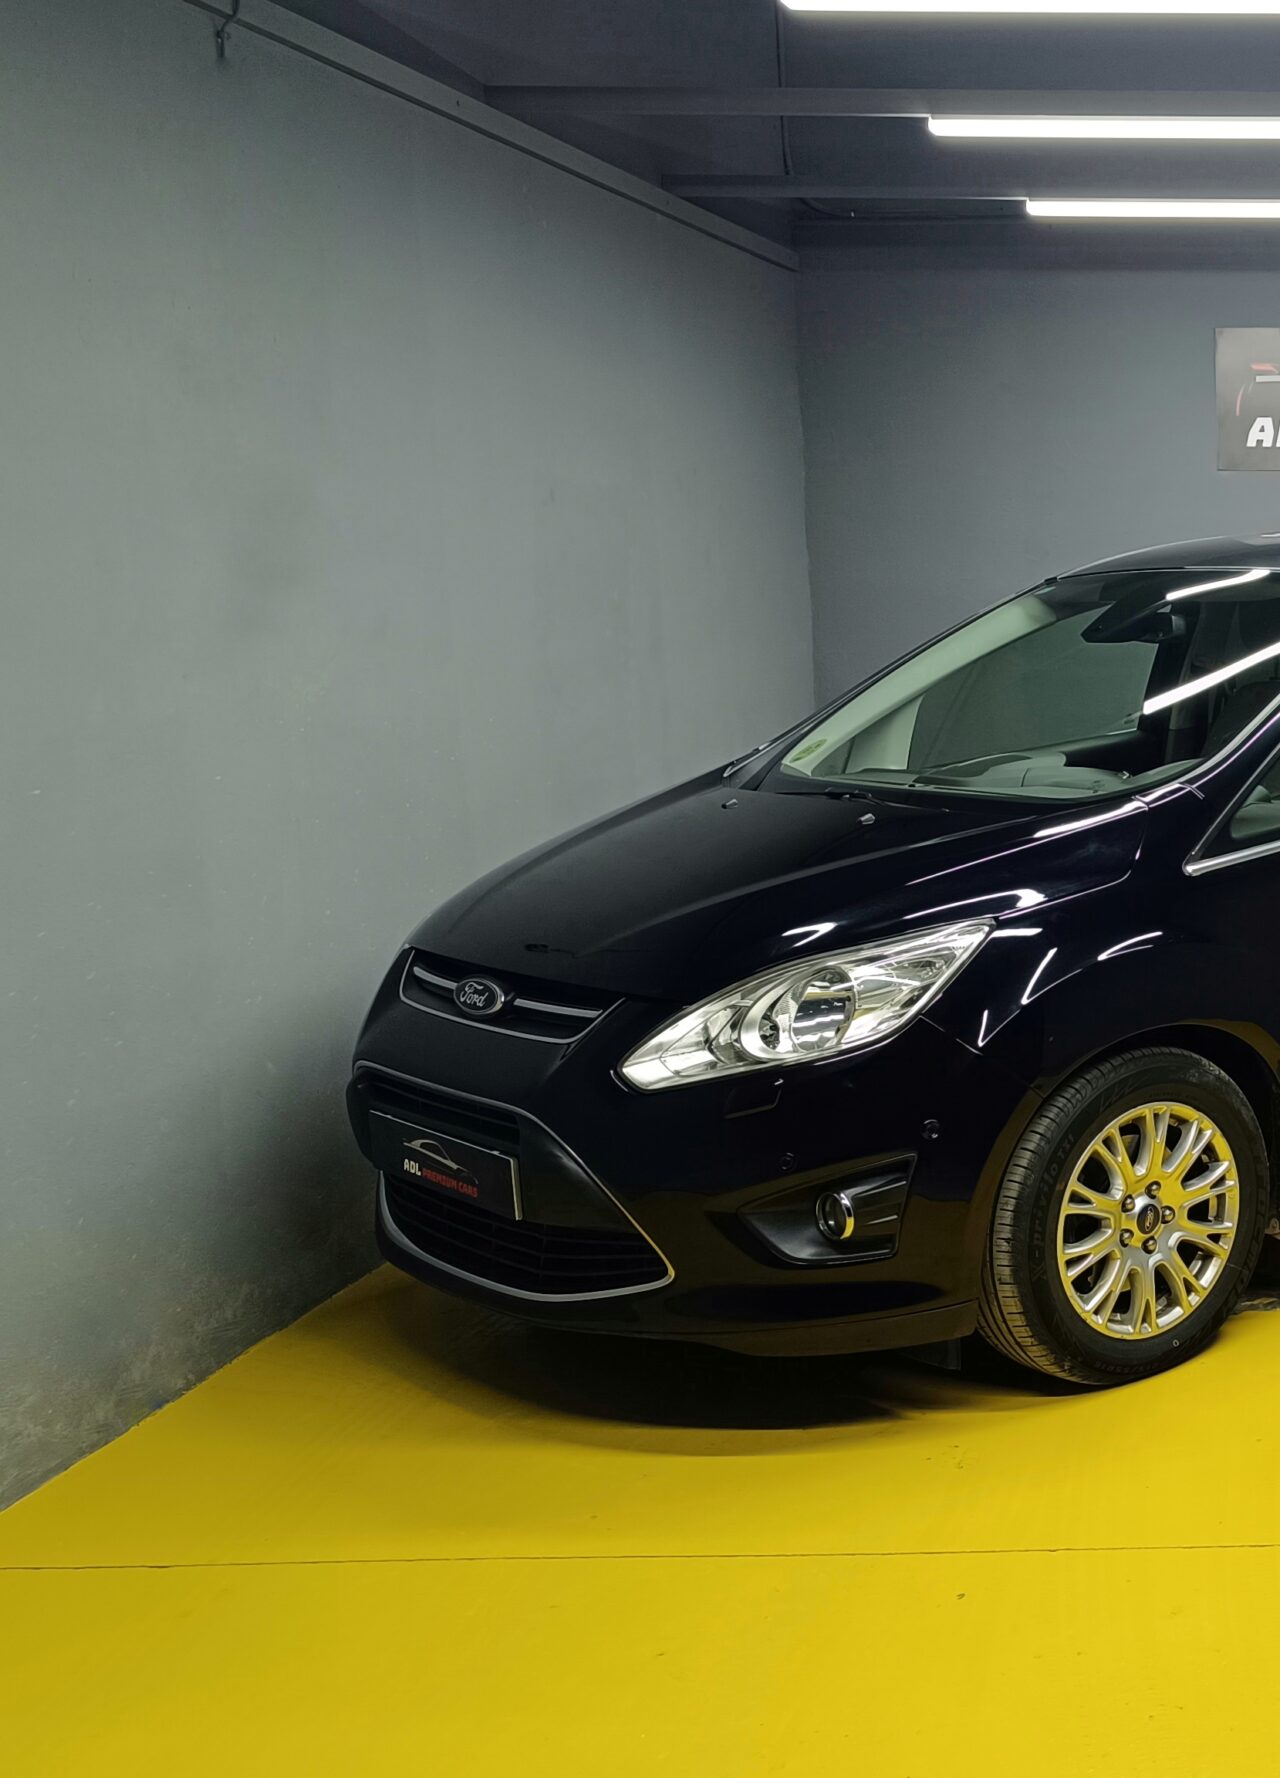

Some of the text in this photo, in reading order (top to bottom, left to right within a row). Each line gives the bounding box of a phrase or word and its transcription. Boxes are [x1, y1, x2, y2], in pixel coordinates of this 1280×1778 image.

[460, 982, 489, 1007] Ford
[403, 1158, 479, 1198] ADL PREMIUM CARS
